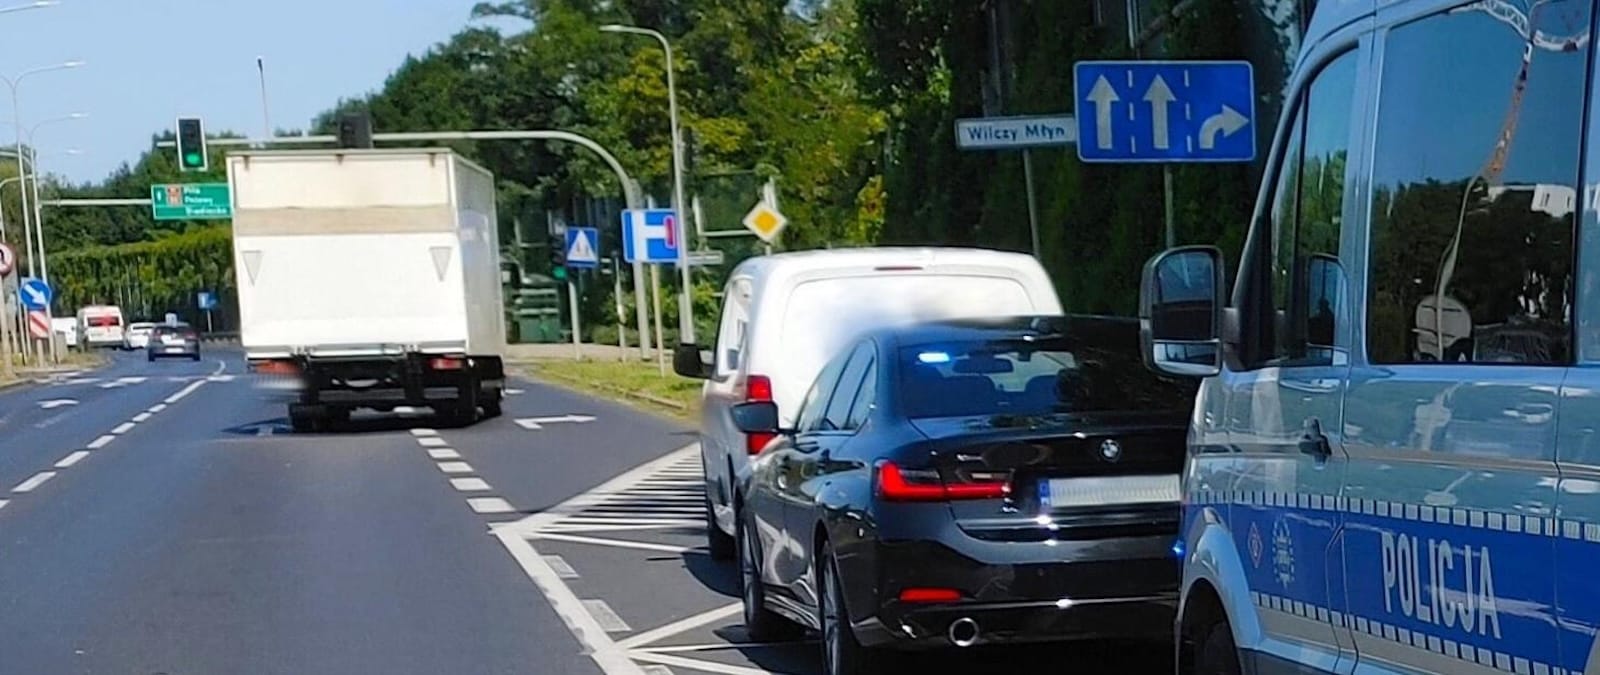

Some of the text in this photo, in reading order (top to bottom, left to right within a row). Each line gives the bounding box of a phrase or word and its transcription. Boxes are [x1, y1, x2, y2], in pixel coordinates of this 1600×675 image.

[967, 123, 1065, 141] Wilczy Młyn
[1381, 531, 1502, 639] POLICJA
